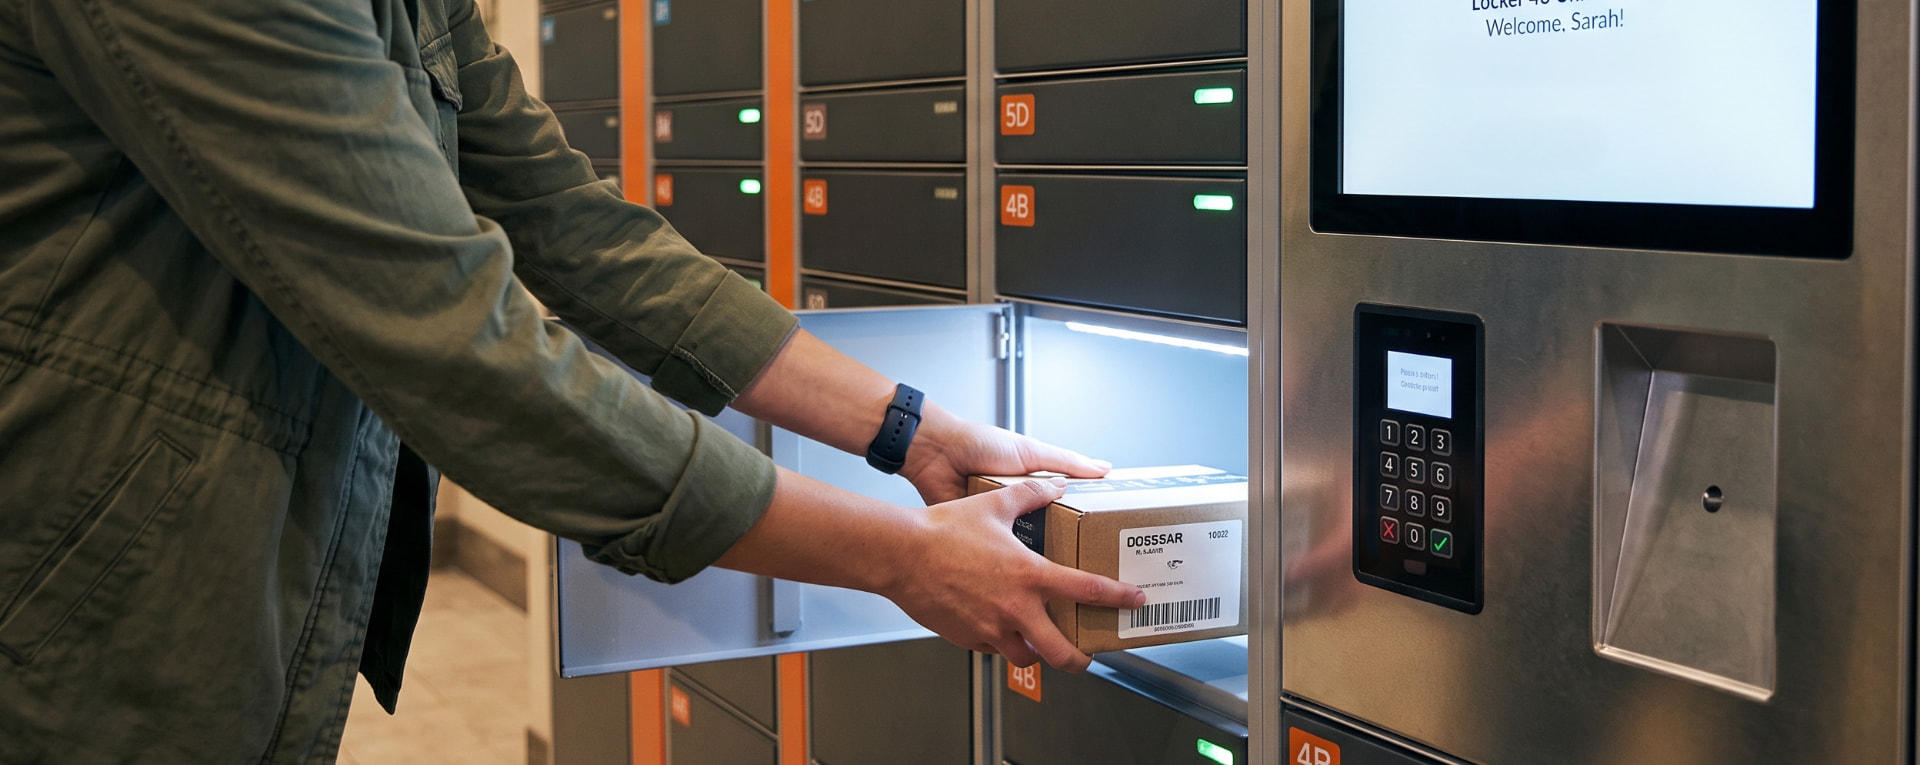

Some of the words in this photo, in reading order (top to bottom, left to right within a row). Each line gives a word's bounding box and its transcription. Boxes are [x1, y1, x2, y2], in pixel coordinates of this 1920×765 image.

[1571, 8, 1624, 31] Sarah!
[1006, 102, 1030, 128] 5D
[1005, 193, 1029, 218] 4B
[1386, 425, 1391, 440] 1
[1410, 429, 1419, 445] 2
[1436, 434, 1445, 450] 3
[1384, 457, 1393, 472] 4
[1410, 462, 1418, 477] 5
[1436, 467, 1445, 483] 6
[1385, 489, 1393, 504] 7
[1410, 495, 1418, 510] 8
[1436, 501, 1445, 516] 9
[1410, 528, 1418, 543] 0
[1012, 665, 1036, 690] 4B
